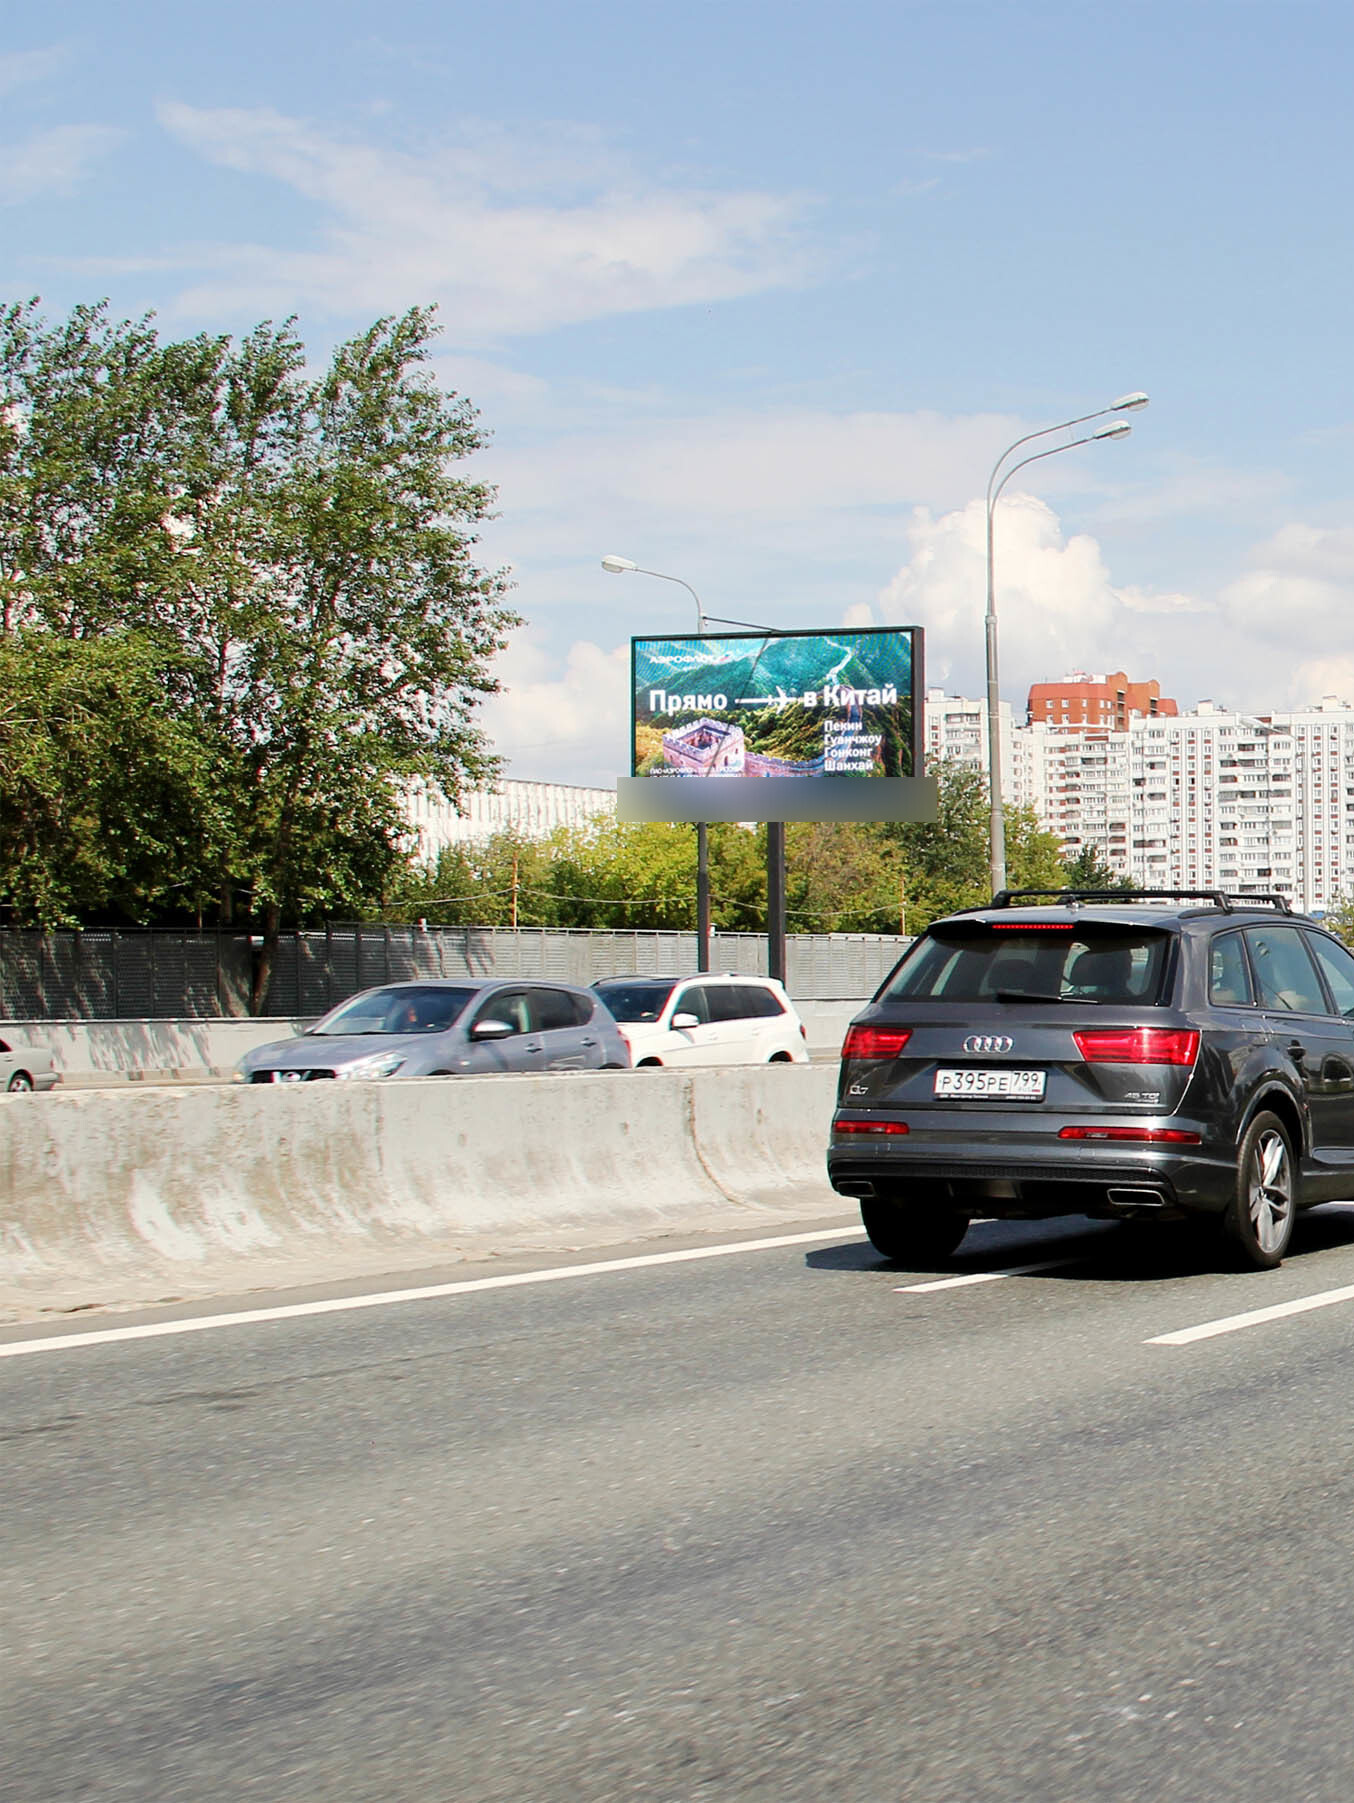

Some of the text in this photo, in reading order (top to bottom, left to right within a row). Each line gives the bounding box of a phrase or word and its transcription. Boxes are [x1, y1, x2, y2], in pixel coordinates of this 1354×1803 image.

[649, 683, 897, 716] Прямо в Китай
[824, 720, 862, 732] Пекин
[824, 734, 882, 748] Гуанчжоу
[824, 747, 873, 760] Гонконг
[824, 758, 874, 772] Шанхай
[1013, 1071, 1039, 1087] 799
[850, 1084, 869, 1095] Q7
